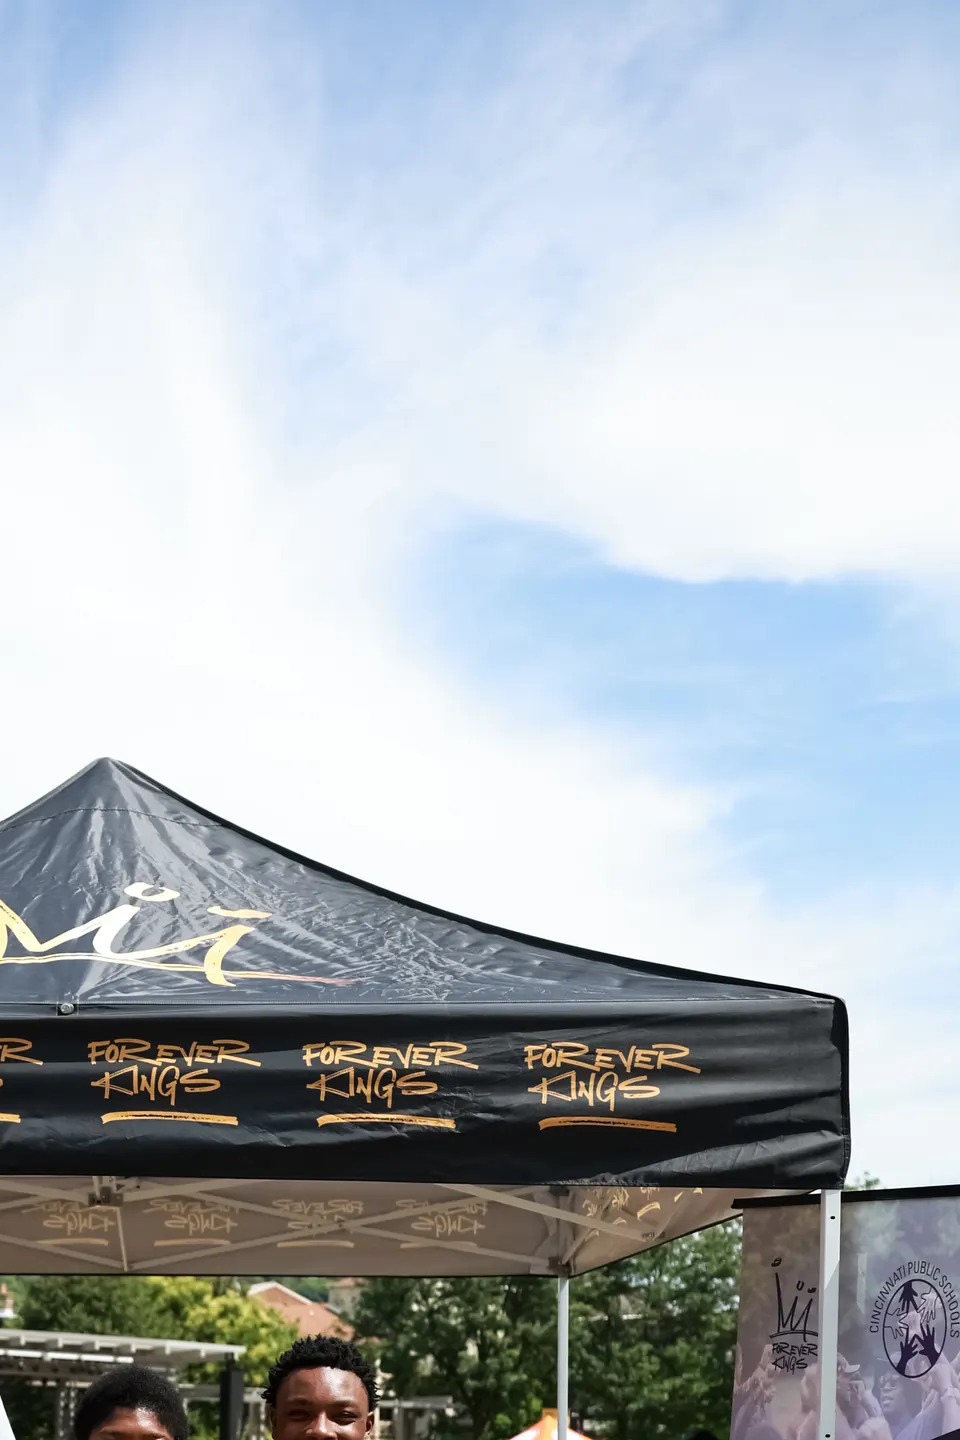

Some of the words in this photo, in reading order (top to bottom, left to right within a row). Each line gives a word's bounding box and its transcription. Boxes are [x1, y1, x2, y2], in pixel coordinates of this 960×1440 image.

[88, 1039, 261, 1067] FOREVER
[302, 1041, 478, 1070] FOREVER
[523, 1042, 701, 1073] FOREVER
[90, 1064, 221, 1105] KINGS
[306, 1065, 439, 1108] KINGS
[528, 1070, 661, 1112] KINGS
[869, 1265, 907, 1333] CINCINNATI
[906, 1261, 940, 1281] PUBLIC
[938, 1275, 960, 1338] SCHOOLS
[772, 1341, 818, 1357] FOREVER
[772, 1355, 808, 1375] KINGS
